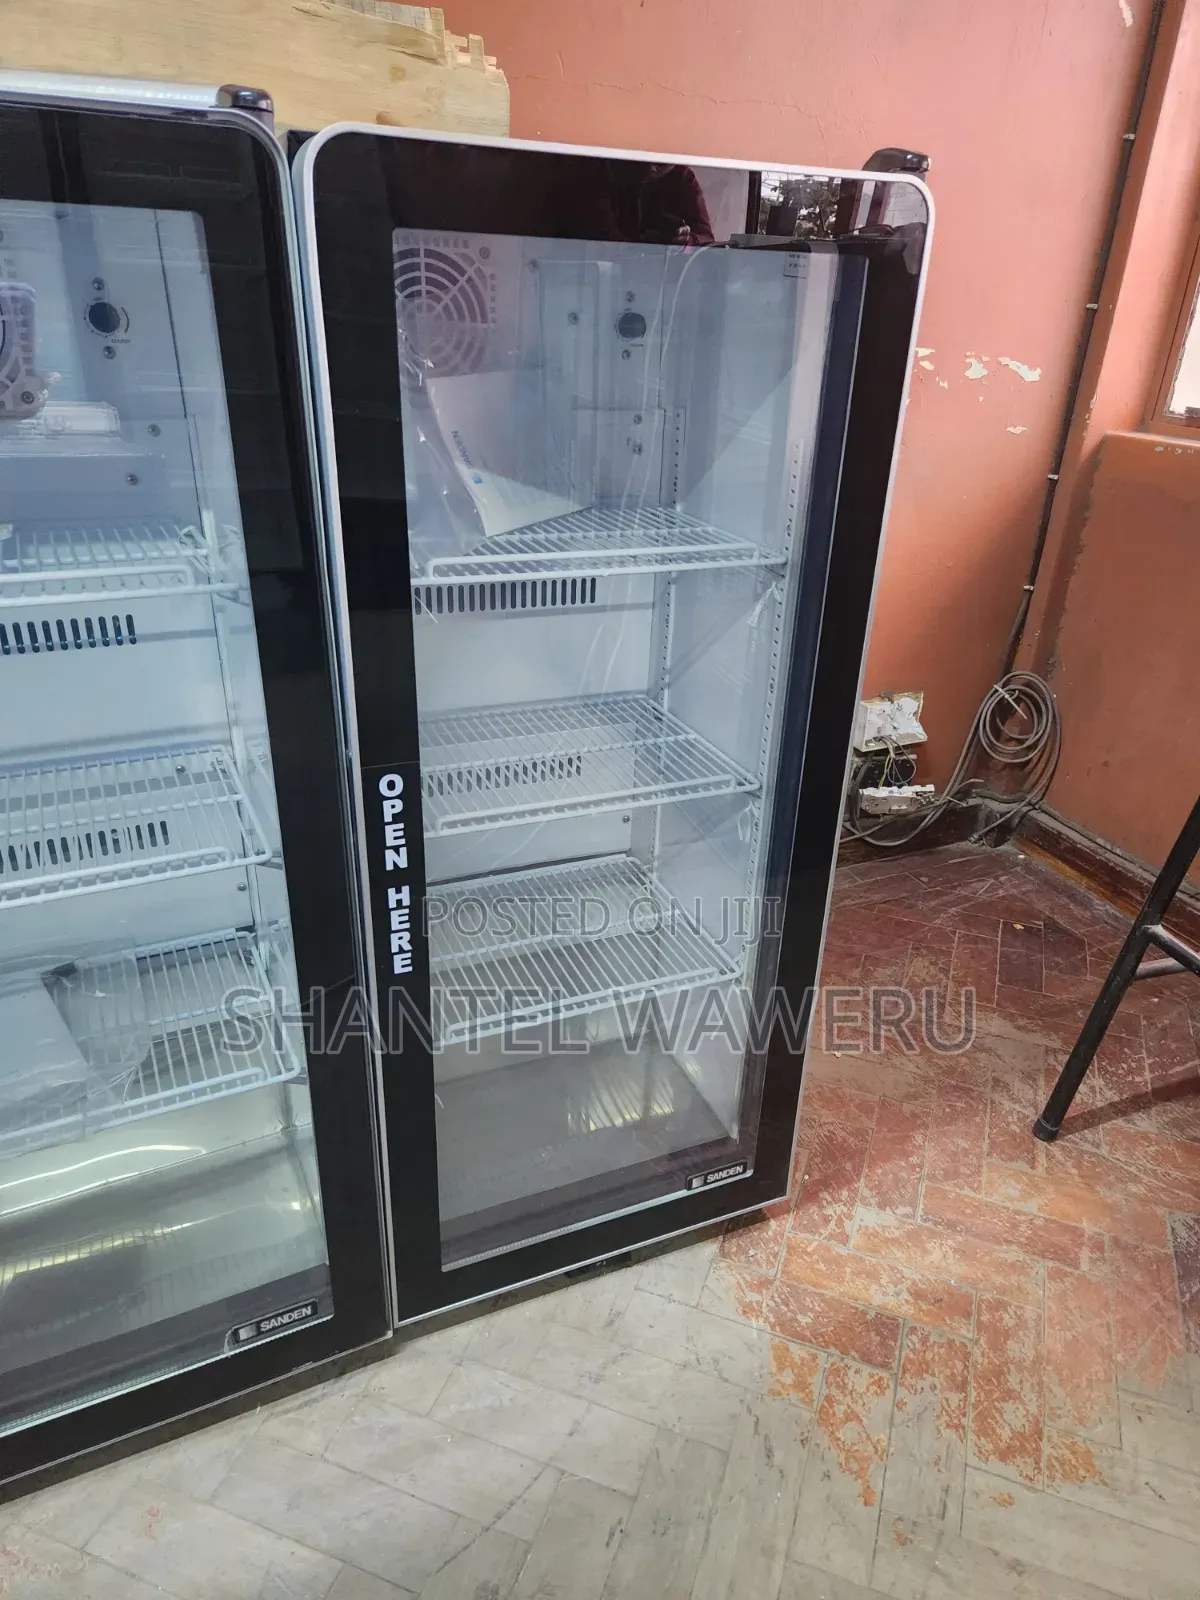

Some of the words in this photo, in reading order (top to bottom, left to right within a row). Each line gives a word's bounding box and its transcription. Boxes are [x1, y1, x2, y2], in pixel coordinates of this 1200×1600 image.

[379, 774, 408, 871] OPEN
[388, 885, 413, 975] HERE
[706, 1164, 744, 1183] SANDEN
[260, 1305, 312, 1332] SANDEN
